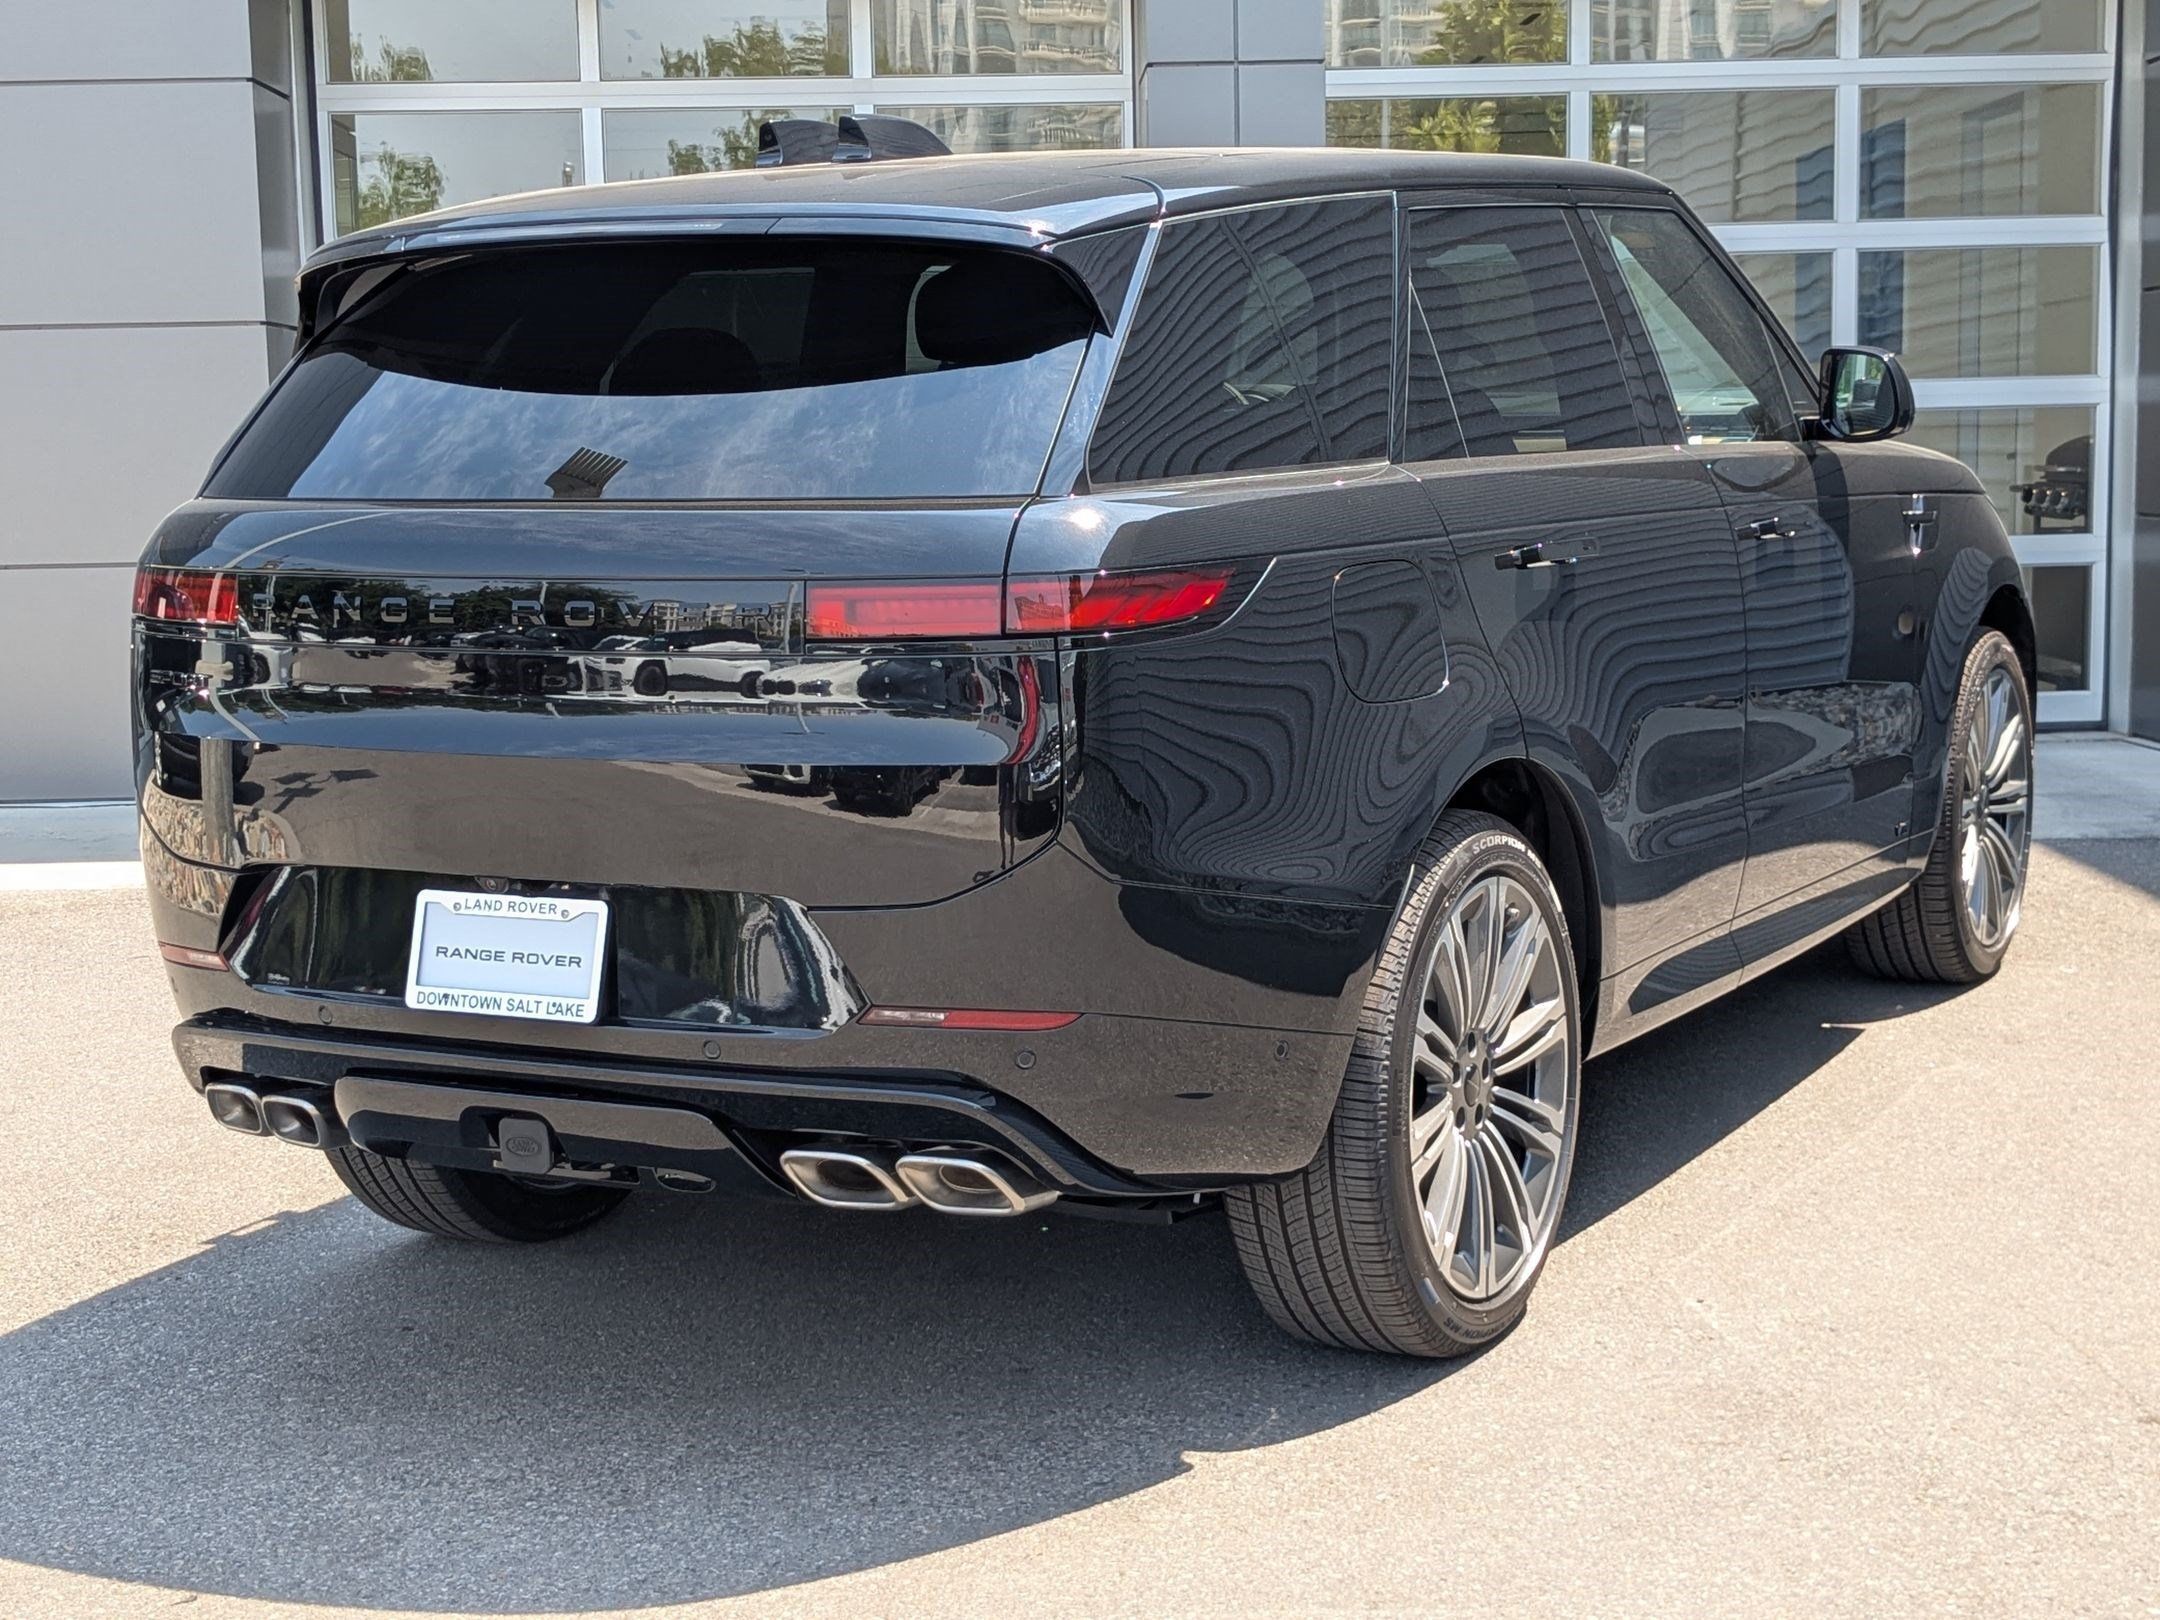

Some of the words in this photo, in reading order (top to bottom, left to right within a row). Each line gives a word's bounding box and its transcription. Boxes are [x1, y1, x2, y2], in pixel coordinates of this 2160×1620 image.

[252, 593, 456, 624] RANGE
[1472, 835, 1526, 855] SCORPION
[464, 898, 503, 912] LAND
[507, 901, 557, 915] ROVER
[435, 946, 505, 962] RANGE
[511, 952, 582, 968] ROVER
[416, 991, 502, 1011] DOWNTOWN
[506, 998, 543, 1015] SALT
[546, 1002, 585, 1018] LAKE
